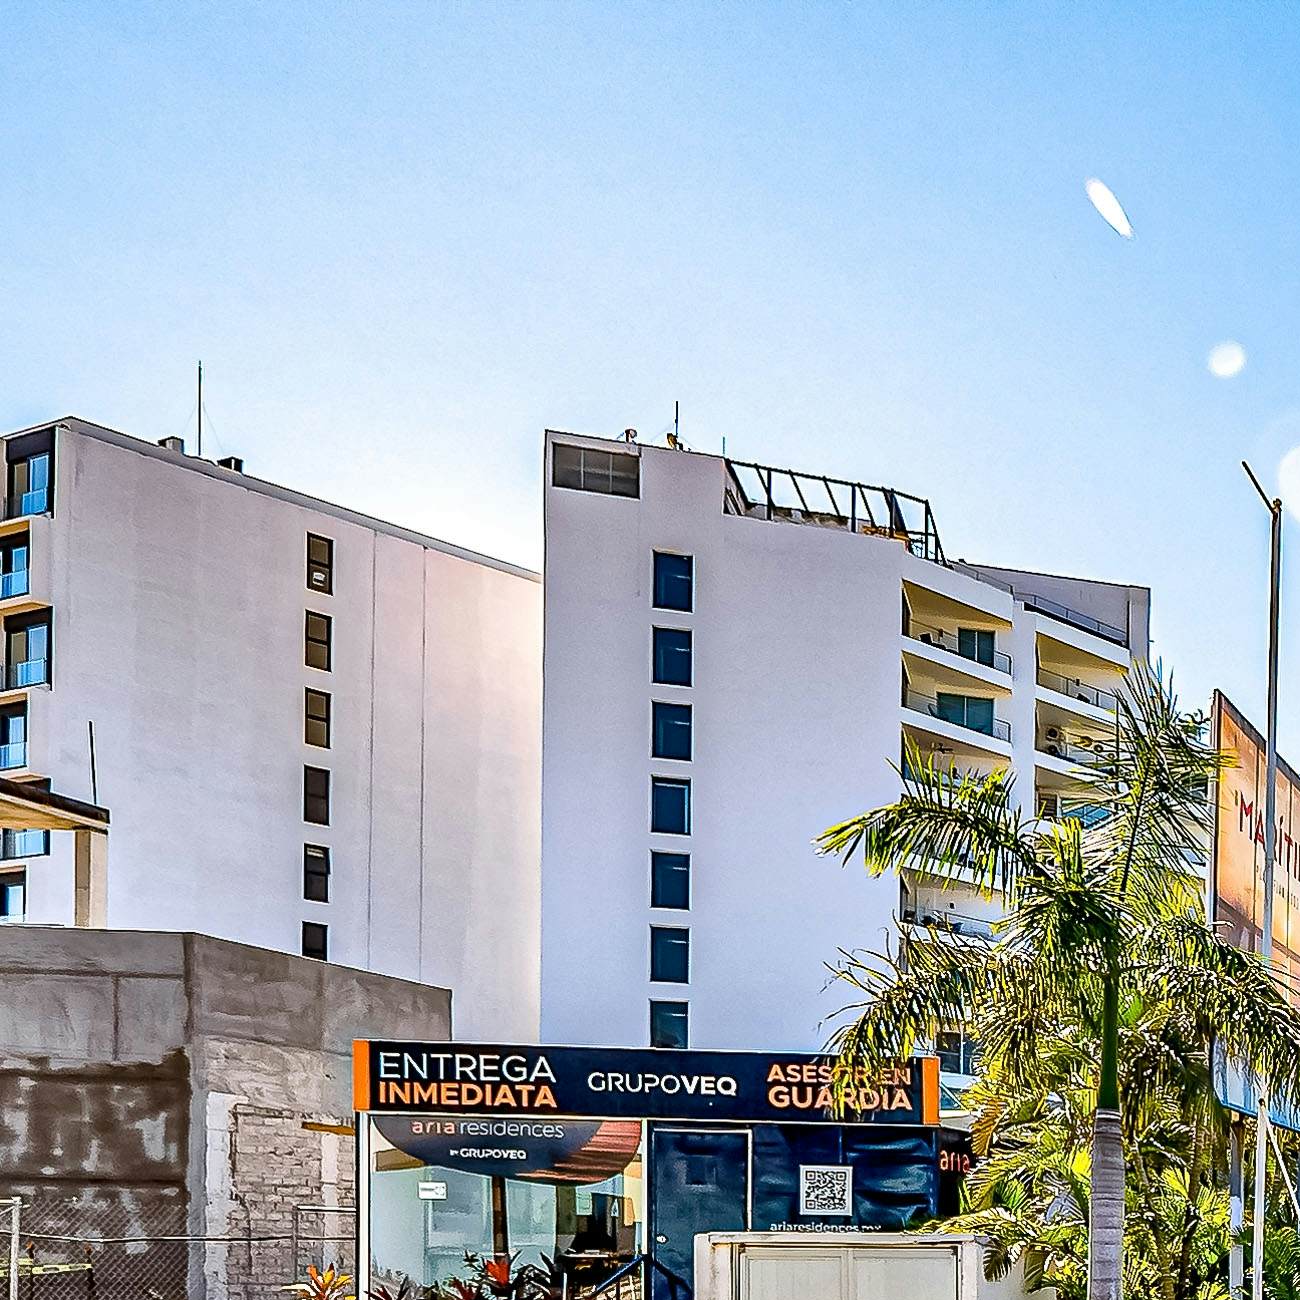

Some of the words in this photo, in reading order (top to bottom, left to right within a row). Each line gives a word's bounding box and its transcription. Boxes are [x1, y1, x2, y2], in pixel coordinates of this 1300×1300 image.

[379, 1051, 557, 1083] ENTREGA
[880, 1067, 912, 1085] EN
[379, 1081, 558, 1109] INMEDIATA
[587, 1071, 737, 1097] GRUPOVEQ
[768, 1085, 913, 1111] GUARDIA
[411, 1121, 456, 1134] aria
[460, 1121, 565, 1138] residences
[460, 1147, 527, 1160] GRUPOVEQ
[940, 1149, 971, 1174] aria
